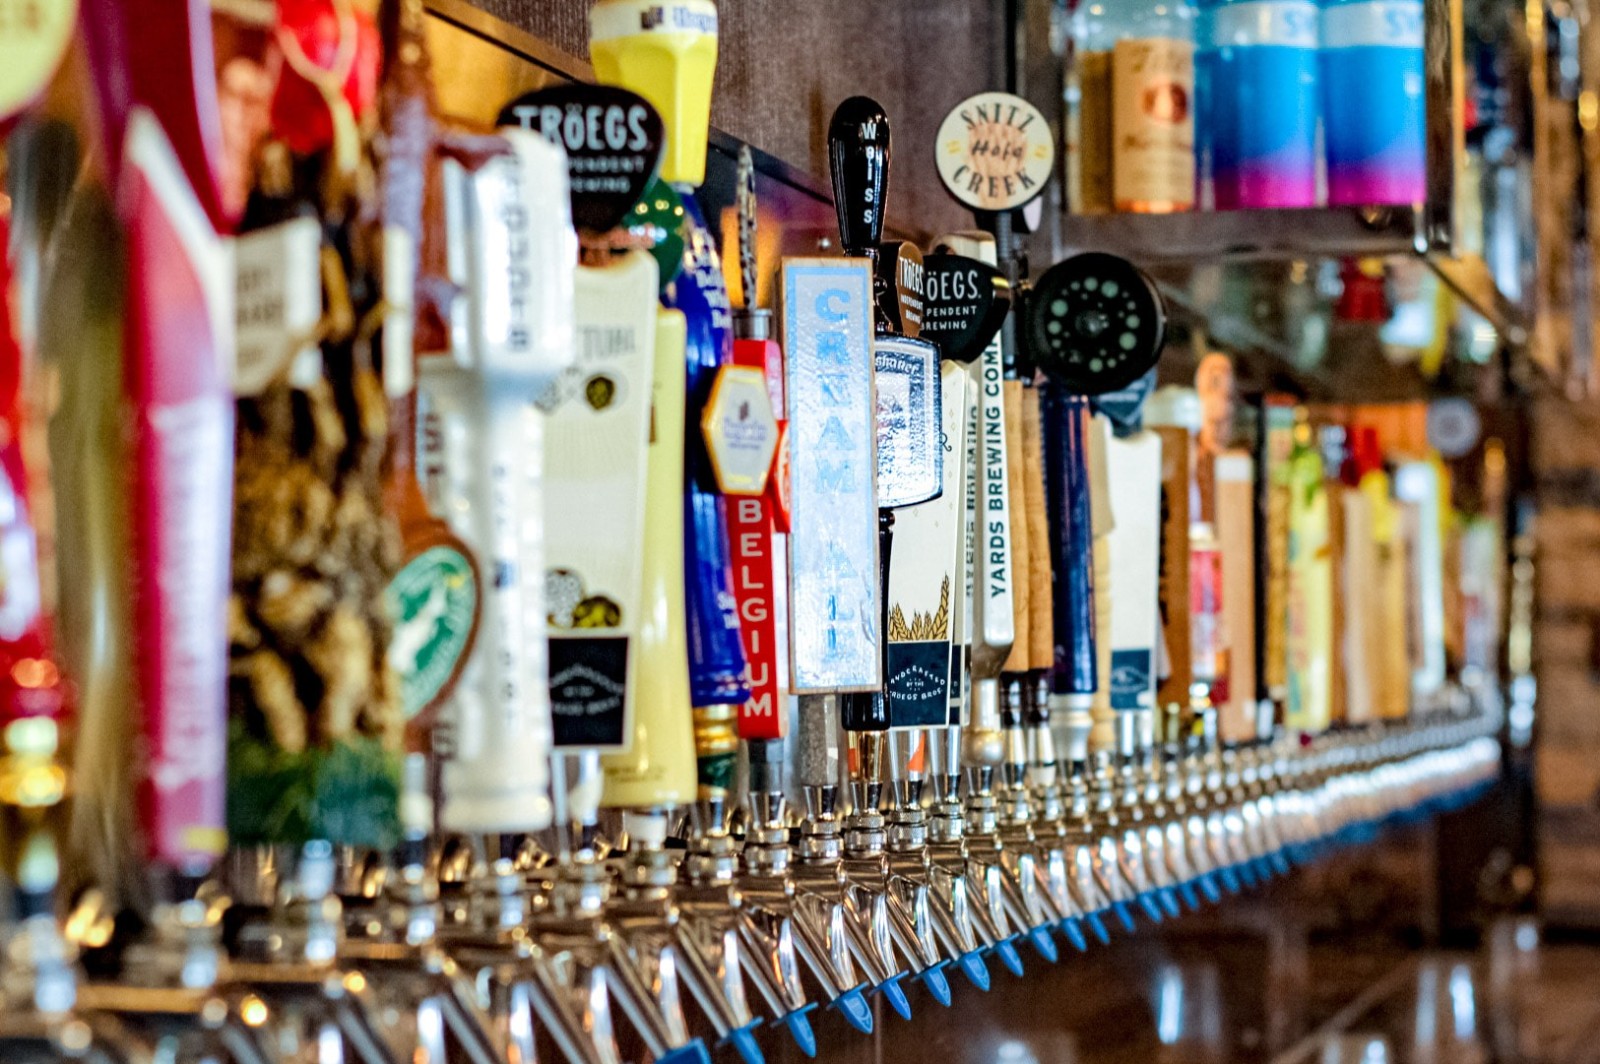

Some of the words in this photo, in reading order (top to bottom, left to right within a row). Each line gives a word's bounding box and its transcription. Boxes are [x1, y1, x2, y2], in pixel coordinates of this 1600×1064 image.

[960, 103, 1035, 133] SNITZ
[953, 164, 1036, 198] CREEK
[926, 305, 977, 317] PENDENT
[986, 406, 1004, 511] BREWING
[989, 521, 1006, 599] YARDS
[738, 499, 772, 718] BELGIUM
[890, 664, 946, 685] ANDCRAFTED
